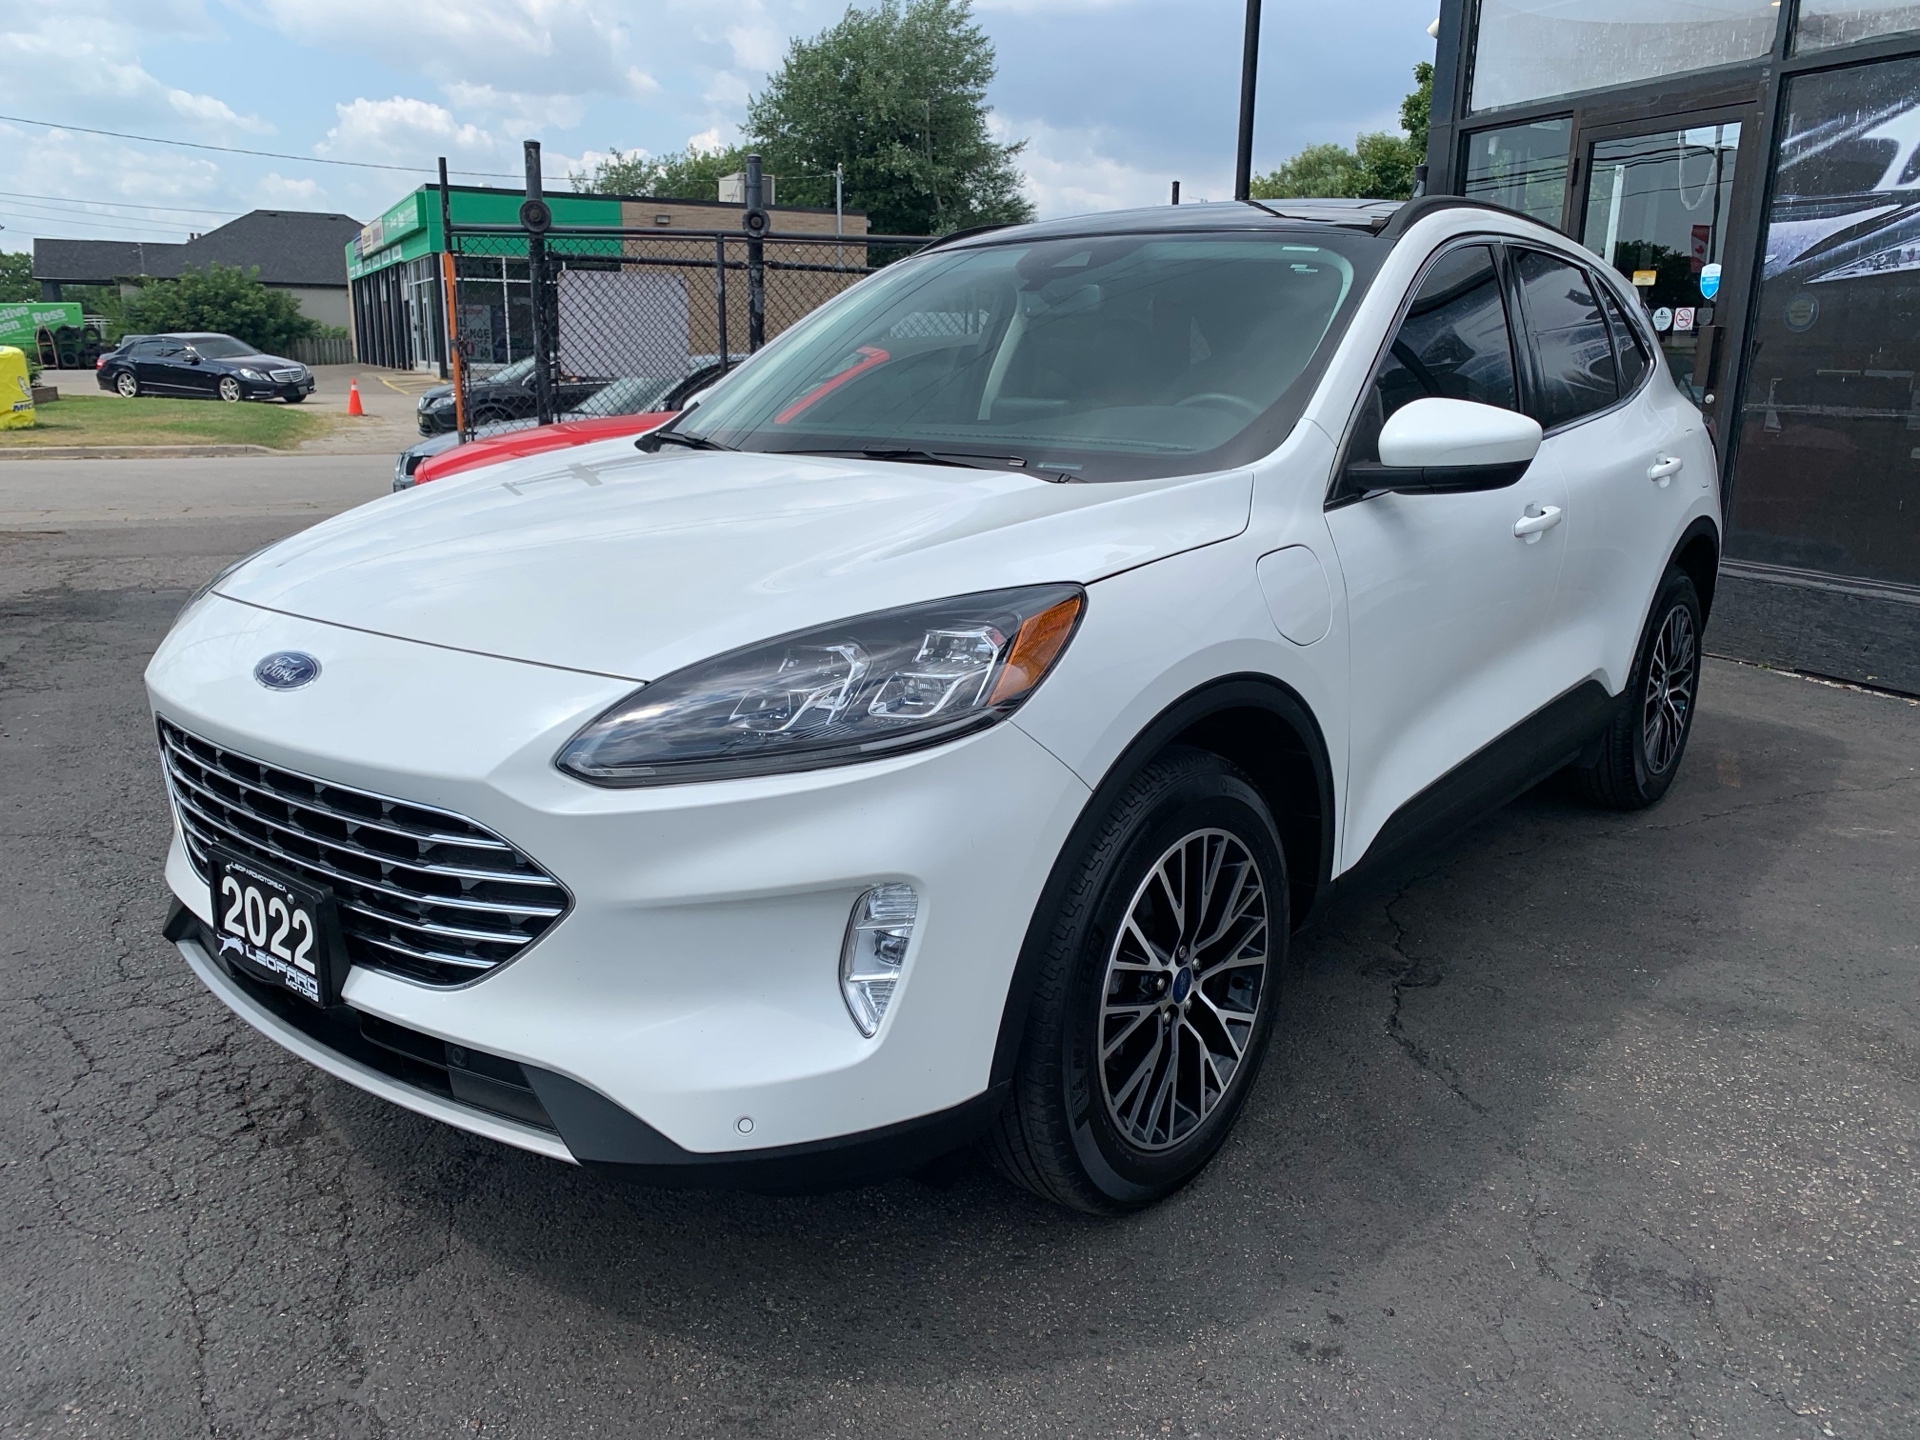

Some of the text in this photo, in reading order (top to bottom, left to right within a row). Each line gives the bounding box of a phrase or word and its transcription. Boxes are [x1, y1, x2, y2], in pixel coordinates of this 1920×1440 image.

[31, 309, 66, 324] Ross
[263, 656, 305, 682] Ford
[222, 875, 316, 975] 2022
[246, 944, 319, 994] LEOPARD
[286, 977, 319, 1003] MOTORS
